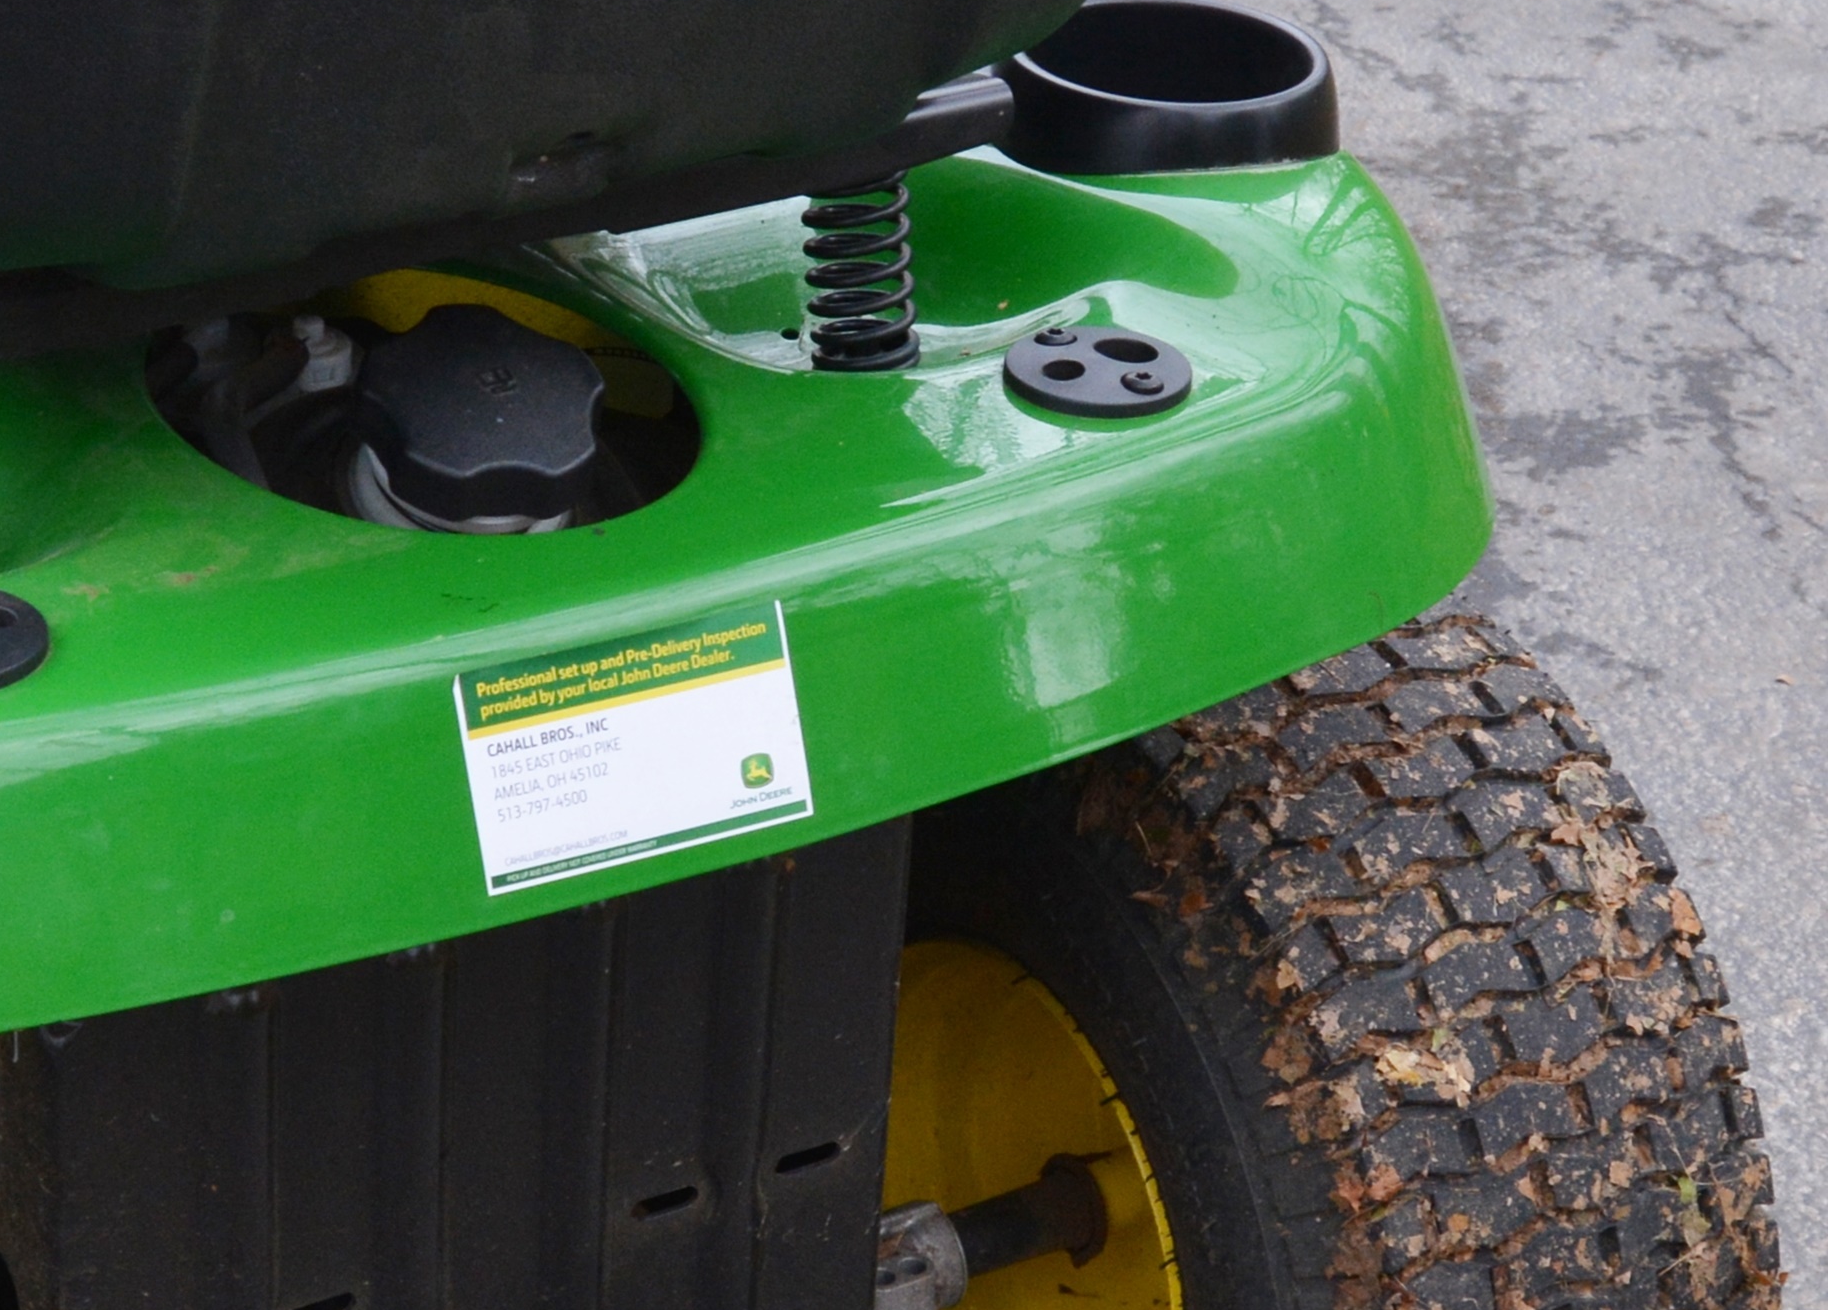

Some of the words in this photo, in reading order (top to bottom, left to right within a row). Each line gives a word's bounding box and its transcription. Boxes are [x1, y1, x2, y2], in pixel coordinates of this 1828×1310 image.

[476, 665, 557, 698] Professional
[558, 663, 579, 679] set
[580, 661, 598, 678] up
[600, 651, 624, 670] and
[625, 636, 701, 663] Pre-Delivery
[702, 623, 766, 646] Inspection
[480, 690, 538, 721] provided
[539, 688, 555, 707] by
[557, 683, 587, 704] your
[588, 673, 618, 692] local
[621, 668, 650, 685] John
[652, 660, 689, 678] Deere
[690, 649, 735, 669] Dealer.
[486, 735, 538, 757] CAHALL
[540, 725, 583, 745] BROS.,
[585, 717, 609, 734] INC
[491, 760, 523, 779] 1845
[525, 752, 556, 772] EAST
[559, 744, 592, 764] OHIO
[594, 736, 621, 755] PIKE
[494, 778, 544, 801] AMELIA,
[547, 771, 567, 789] OH
[569, 762, 609, 782] 45102
[729, 795, 757, 809] JOHN
[758, 786, 793, 803] DEERE
[497, 789, 588, 823] 513-797-4500
